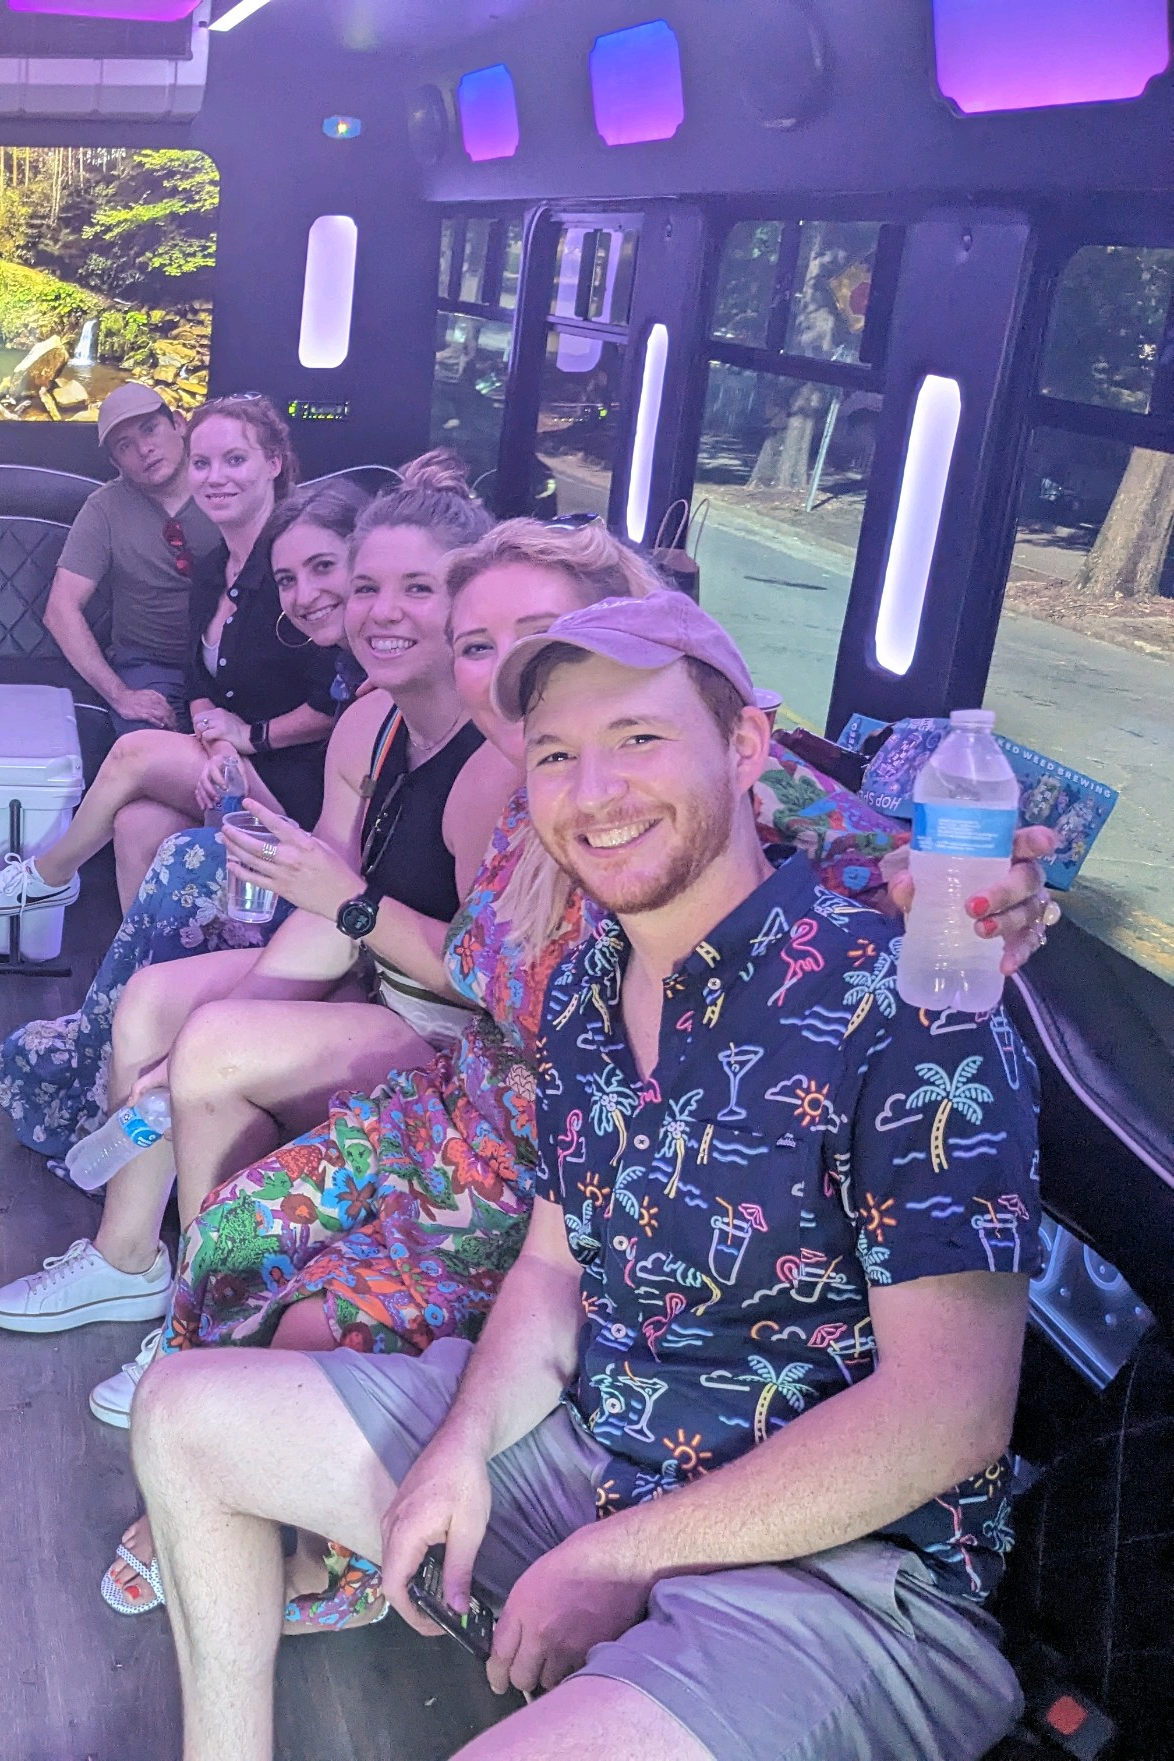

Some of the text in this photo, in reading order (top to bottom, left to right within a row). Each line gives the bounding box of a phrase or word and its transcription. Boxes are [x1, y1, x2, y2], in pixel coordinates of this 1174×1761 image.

[998, 739, 1112, 798] KED WEED BREWING
[875, 794, 902, 812] HOP
